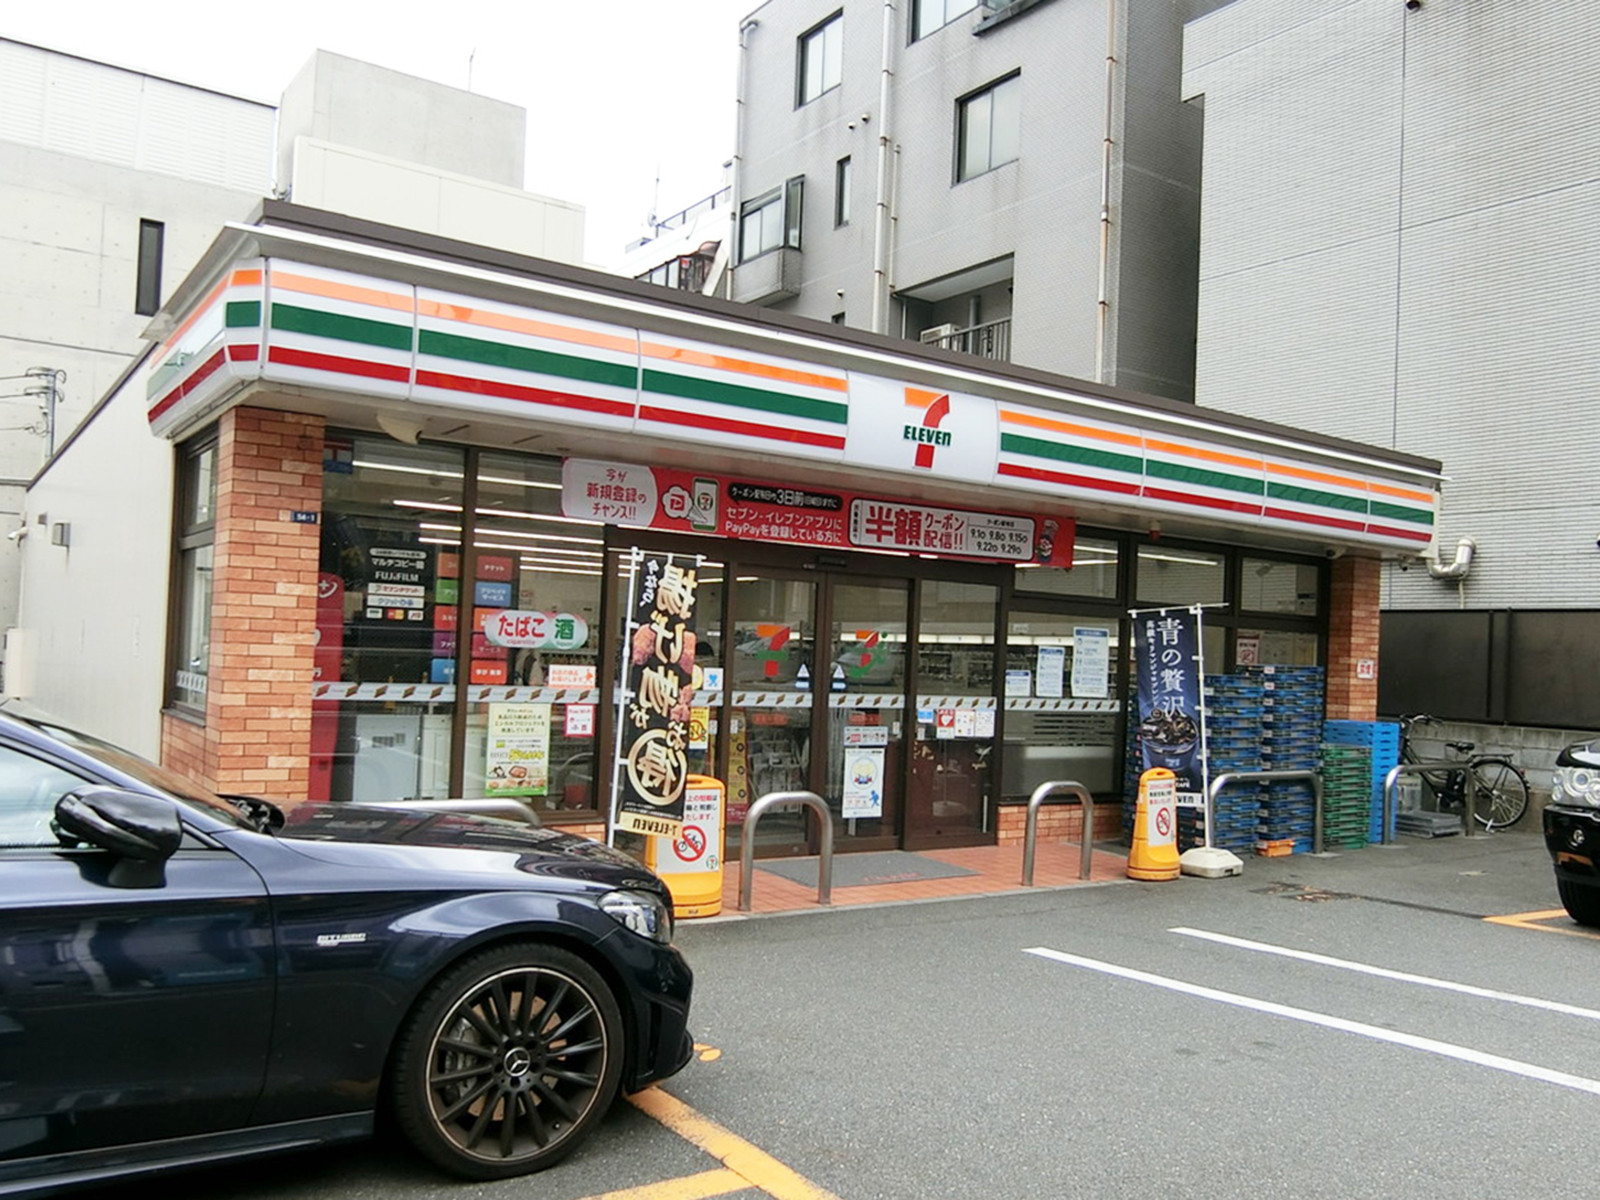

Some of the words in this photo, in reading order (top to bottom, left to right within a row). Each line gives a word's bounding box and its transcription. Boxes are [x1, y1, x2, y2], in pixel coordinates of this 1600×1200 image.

[586, 482, 647, 504] 新規登録の
[865, 505, 922, 547] 半額
[925, 512, 965, 531] クーポン
[375, 571, 419, 582] FUJIFILM
[498, 615, 545, 638] たばこ
[554, 618, 575, 640] 酒
[1156, 617, 1187, 719] 青の贅沢
